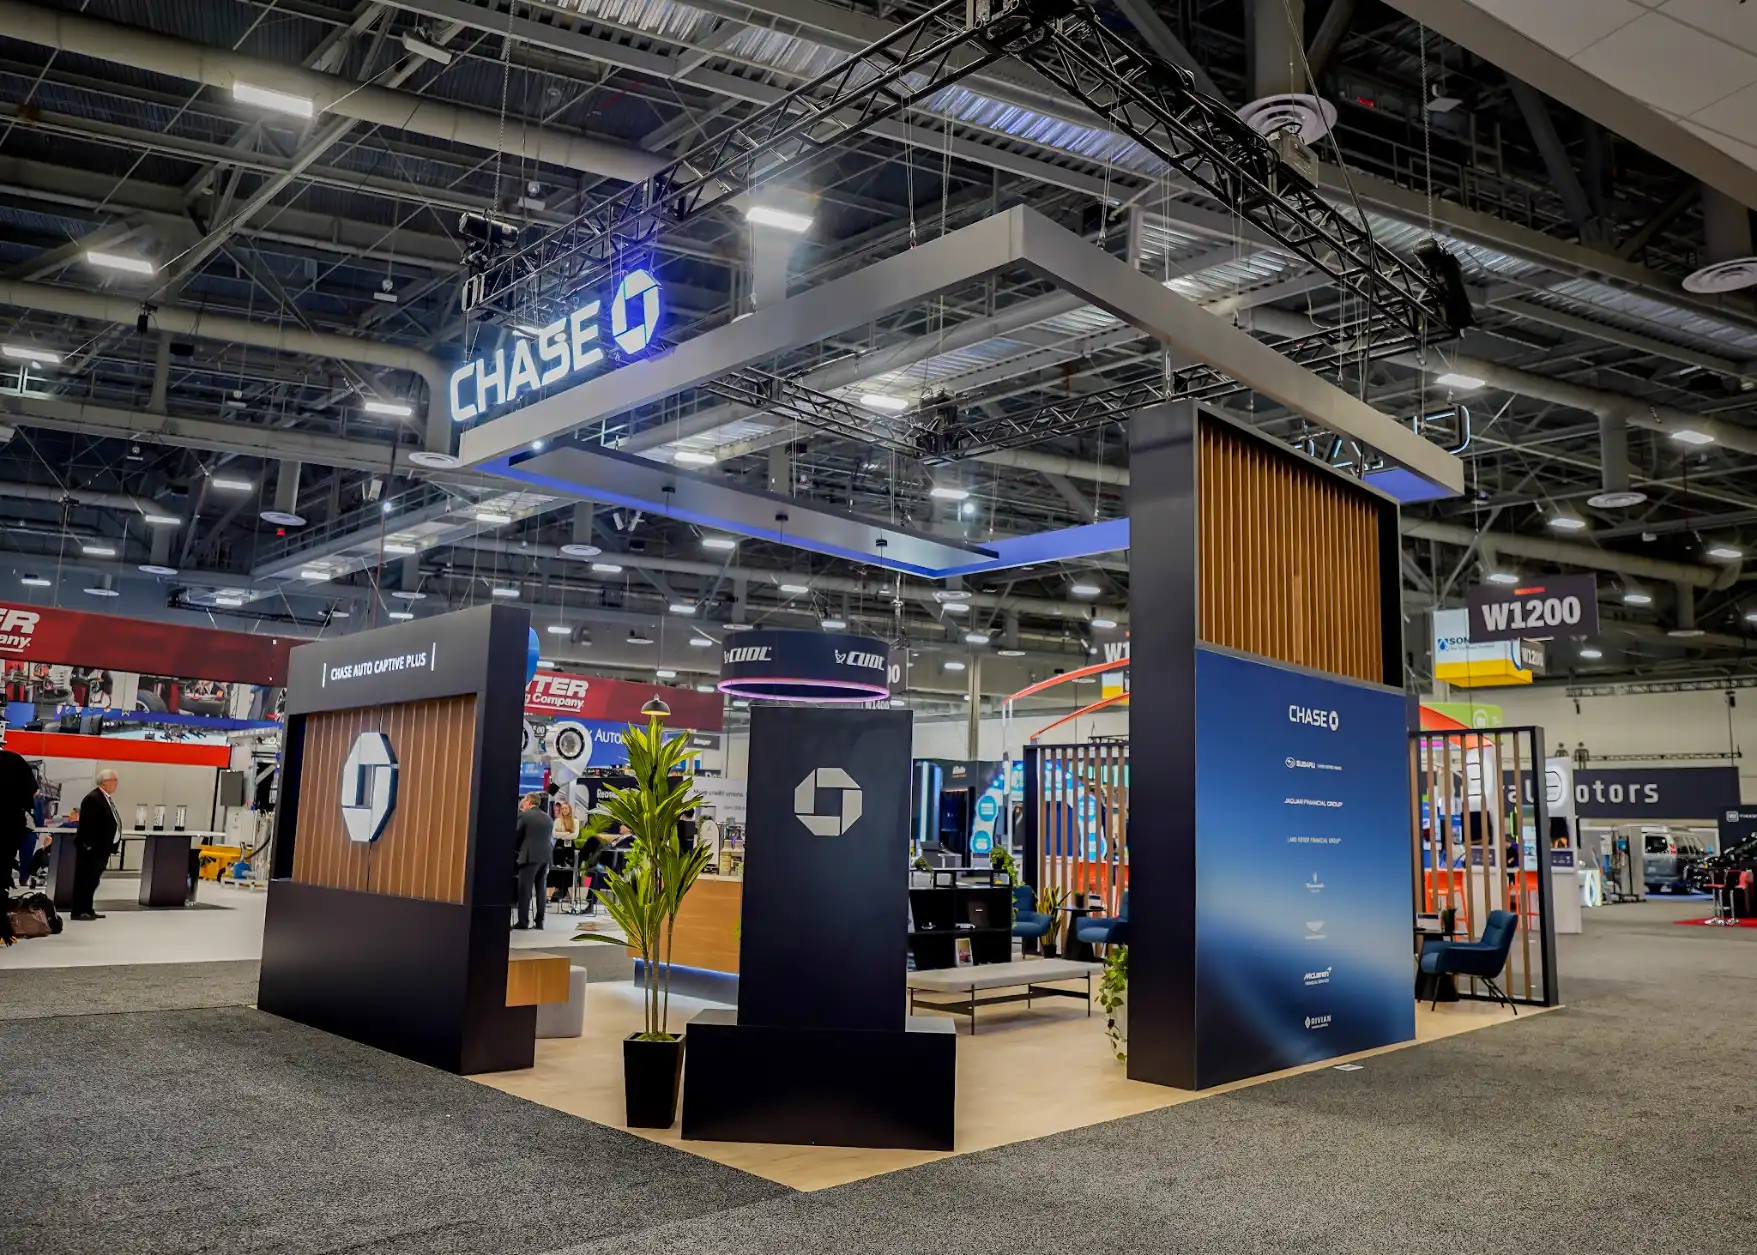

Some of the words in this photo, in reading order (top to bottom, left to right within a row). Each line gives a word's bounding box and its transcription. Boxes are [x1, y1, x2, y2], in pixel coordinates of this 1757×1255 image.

[450, 300, 604, 422] CHASE
[0, 608, 40, 634] R
[1481, 595, 1582, 632] W1200
[331, 665, 352, 681] CHASE
[353, 661, 373, 677] AUTO
[374, 656, 404, 674] CAPTIVE
[405, 652, 427, 668] PLUS
[846, 651, 885, 671] CUDL
[526, 675, 589, 698] TER
[1288, 705, 1328, 728] CHASE
[594, 727, 623, 745] AUTO
[1296, 760, 1316, 769] SUBARU
